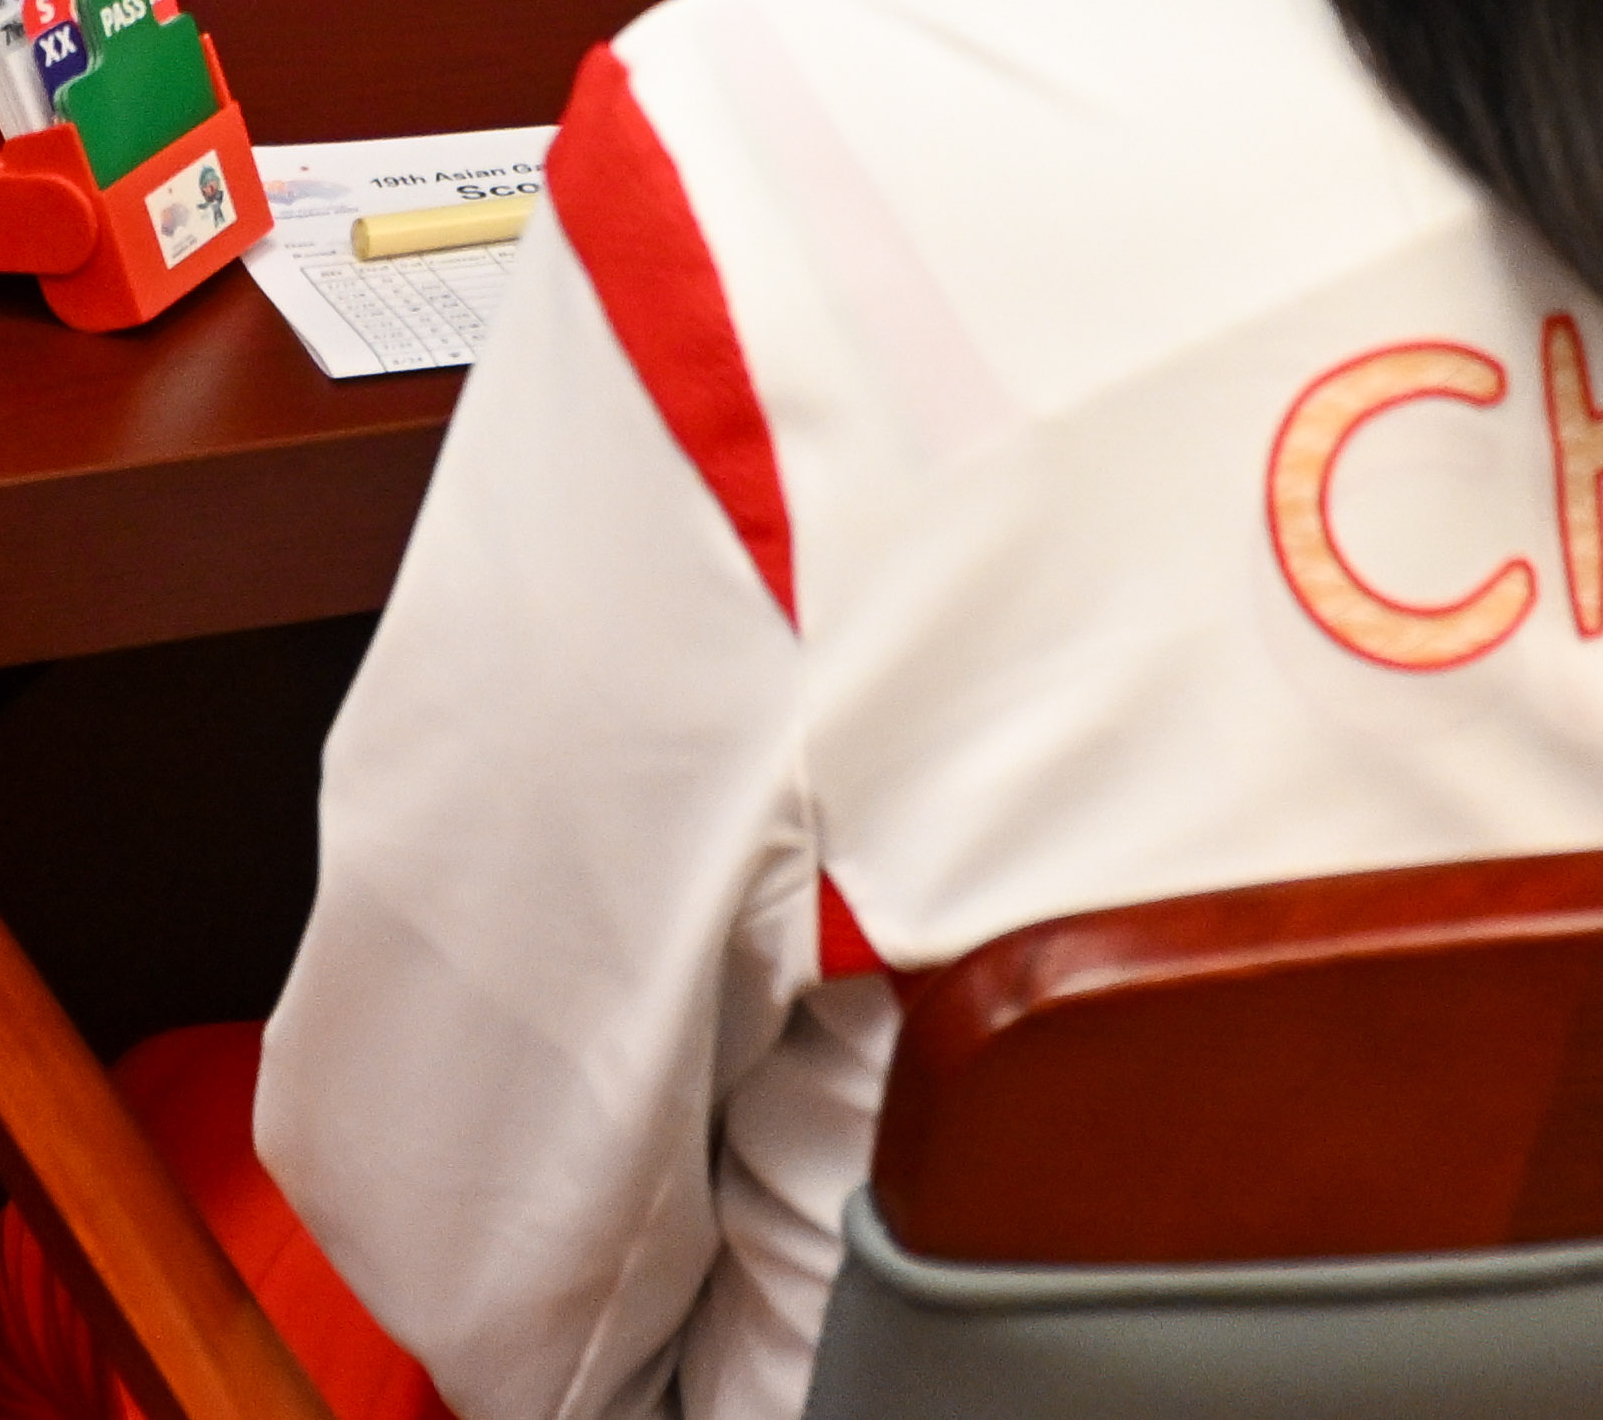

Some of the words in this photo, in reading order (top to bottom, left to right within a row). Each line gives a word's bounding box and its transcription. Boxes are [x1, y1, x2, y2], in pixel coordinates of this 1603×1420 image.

[38, 25, 78, 68] XX
[369, 174, 427, 189] 19th
[435, 167, 507, 183] Asian
